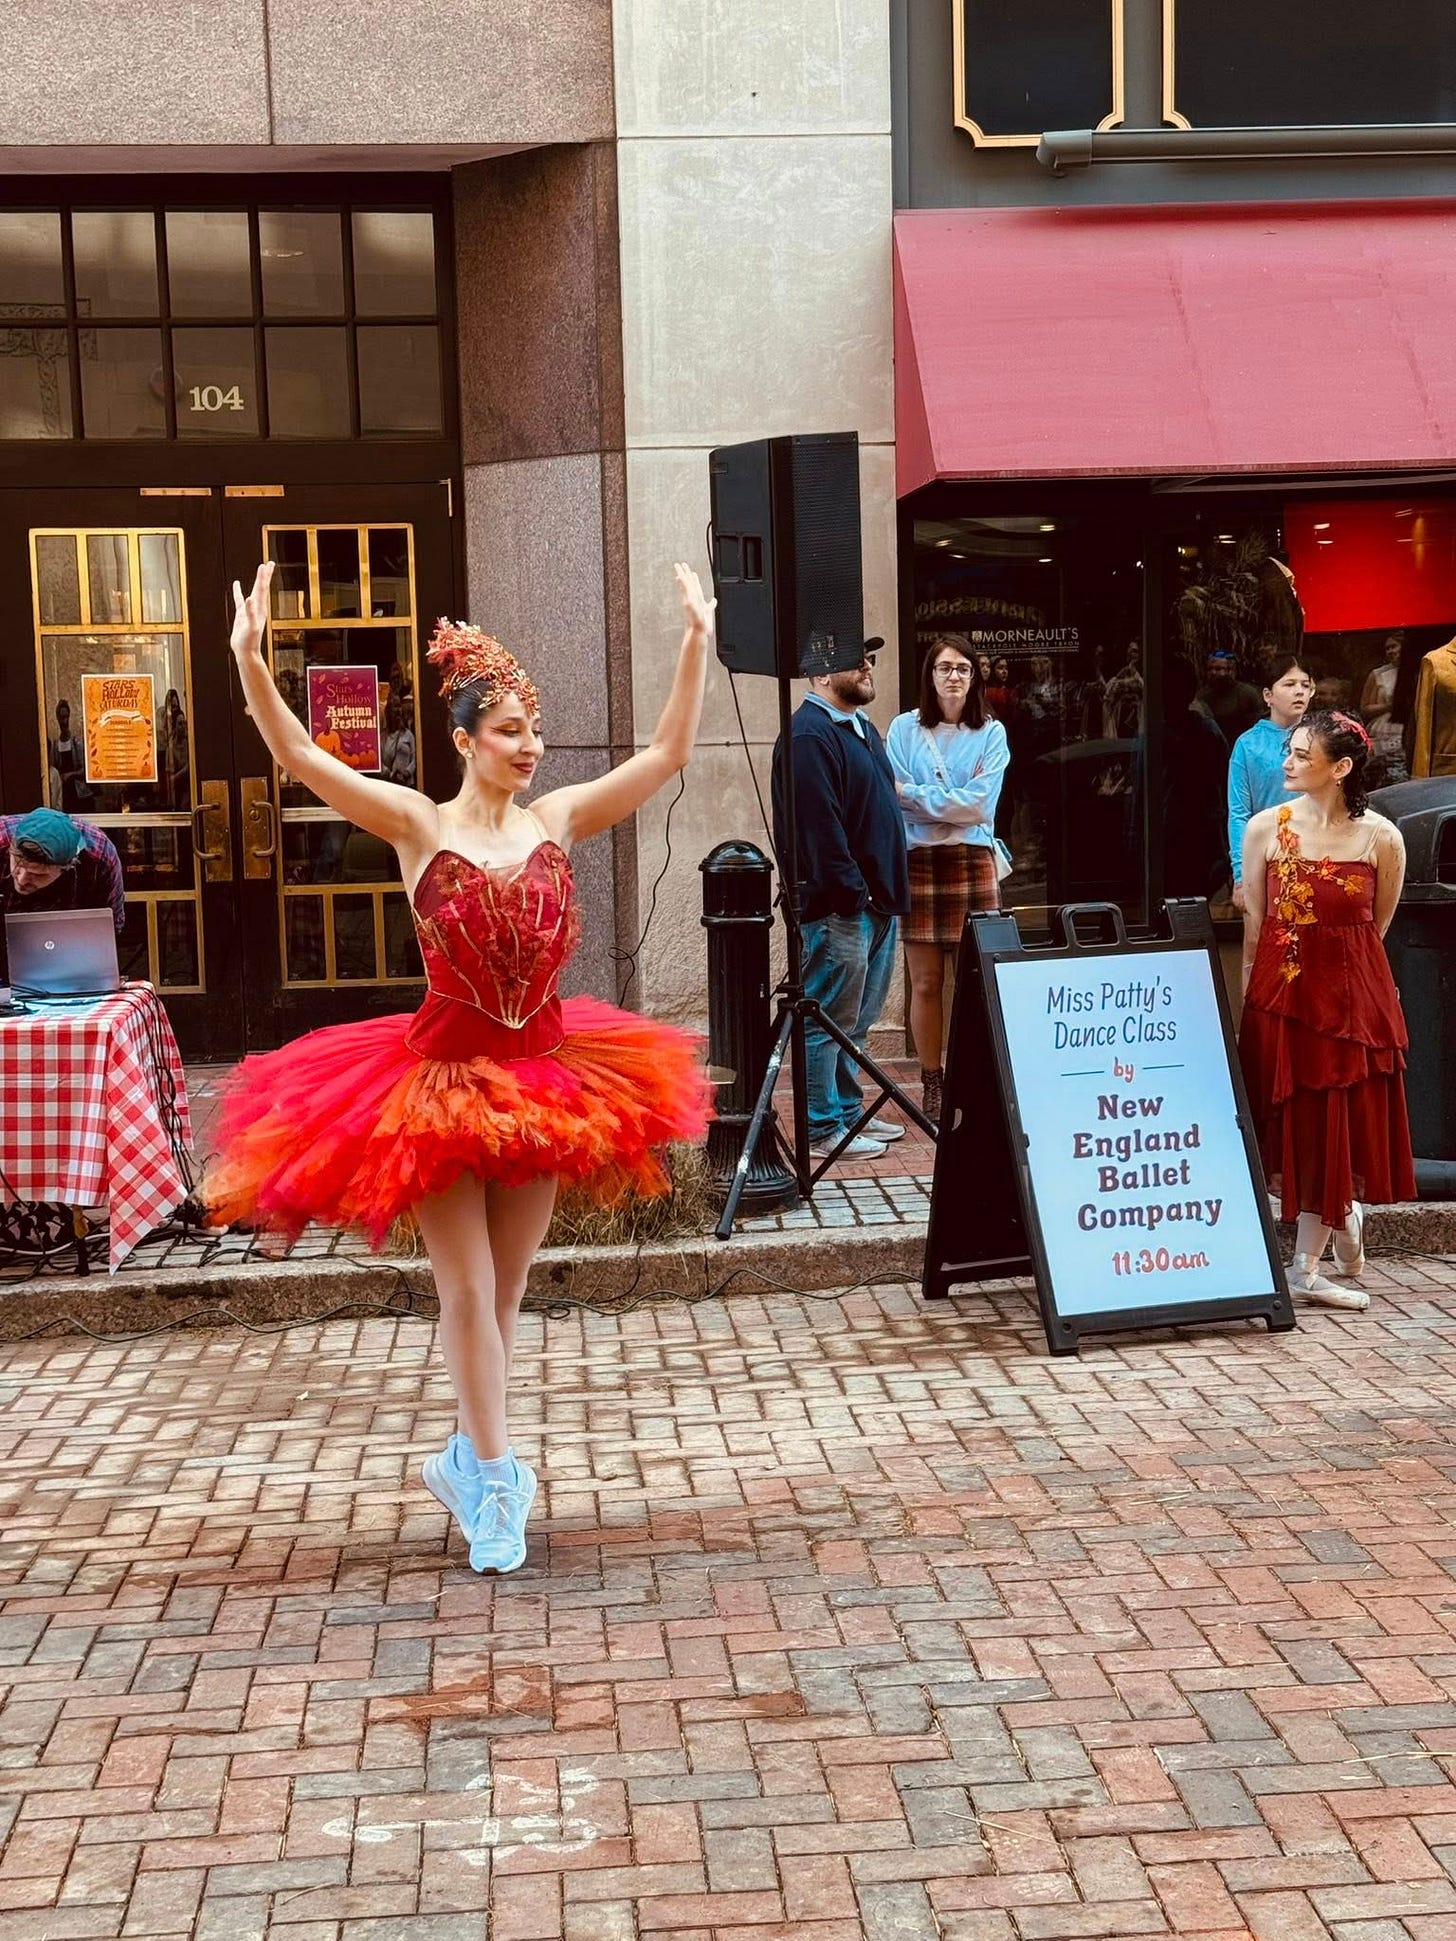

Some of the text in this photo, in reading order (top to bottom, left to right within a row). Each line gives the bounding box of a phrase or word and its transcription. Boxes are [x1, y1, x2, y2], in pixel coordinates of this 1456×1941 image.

[189, 386, 244, 411] 104
[983, 627, 1079, 642] MORNEAULT'S
[102, 680, 136, 691] STARS
[102, 688, 140, 701] HOLLOW
[326, 683, 353, 698] Stars
[325, 705, 372, 718] Autumn
[336, 694, 373, 704] Hollow
[330, 716, 377, 730] Festival
[1047, 976, 1172, 1014] Miss Patty's
[1054, 1015, 1177, 1049] Dance Class
[1113, 1056, 1135, 1083] by
[1097, 1094, 1164, 1120] New
[1073, 1123, 1200, 1162] England
[1098, 1159, 1191, 1193] Ballet
[1077, 1199, 1223, 1231] Company
